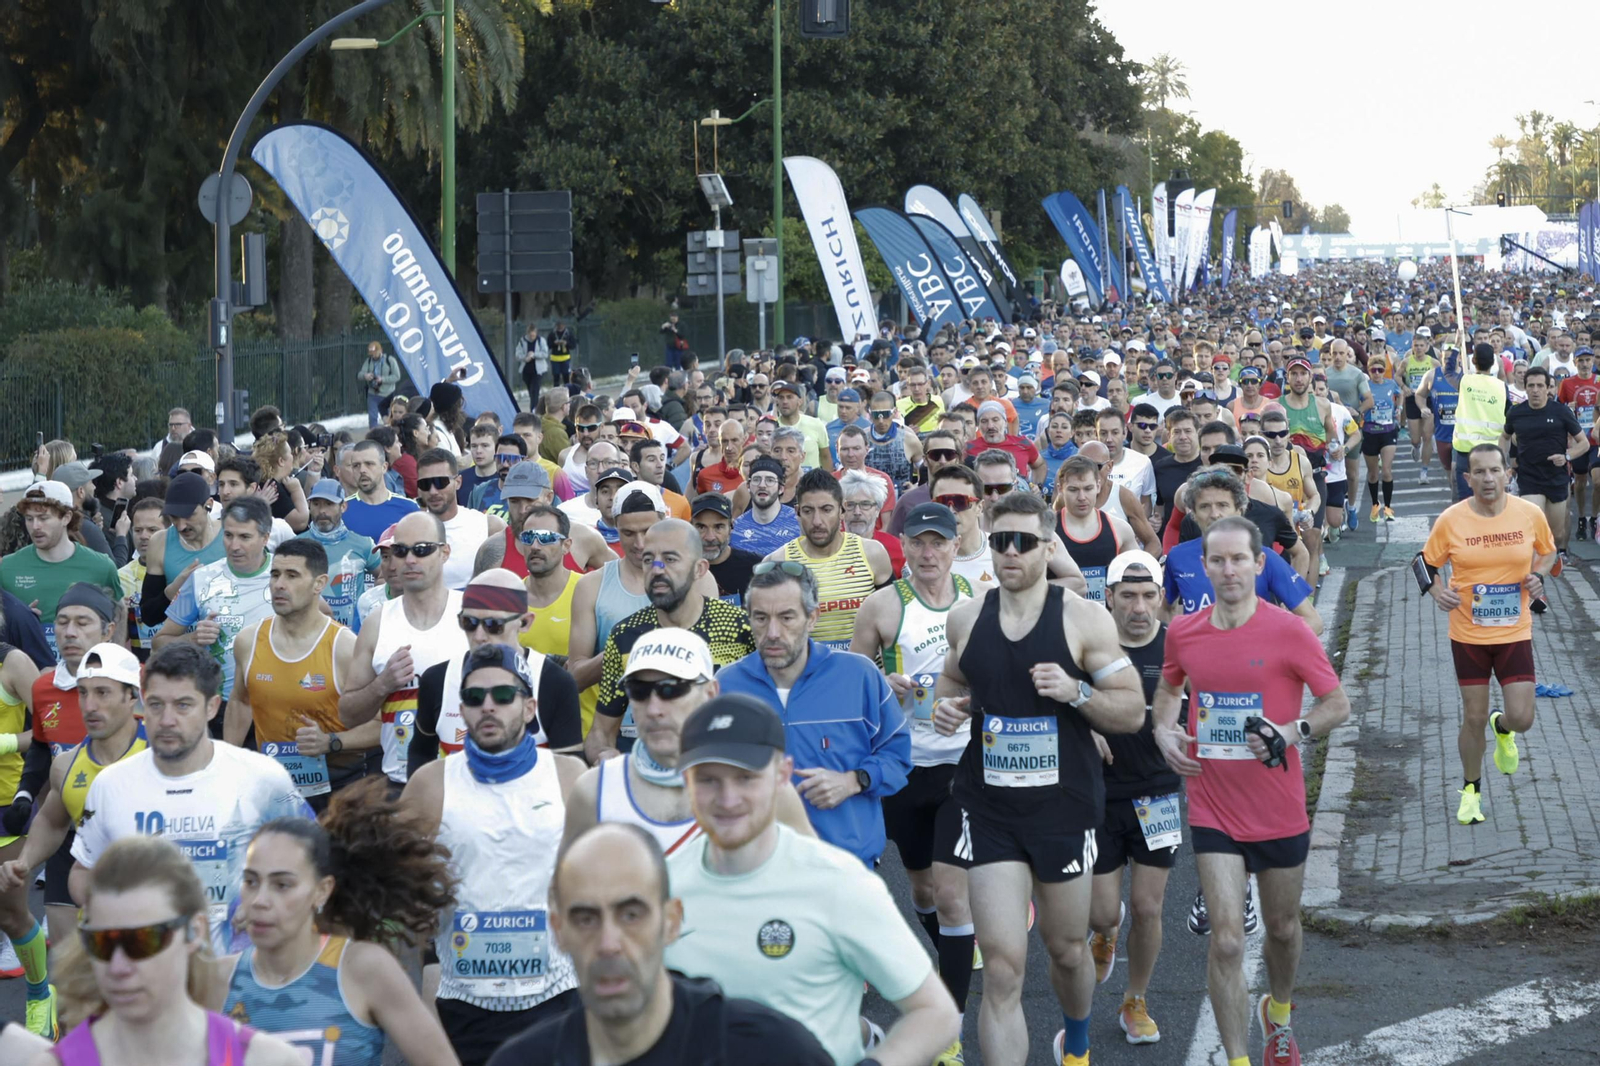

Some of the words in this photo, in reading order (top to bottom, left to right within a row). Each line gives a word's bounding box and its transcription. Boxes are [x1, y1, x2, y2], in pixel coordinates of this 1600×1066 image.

[1465, 536, 1482, 547] TOP
[1482, 530, 1524, 544] RUNNERS
[1086, 590, 1101, 600] ING
[1489, 585, 1516, 593] ZURICH
[1472, 607, 1502, 617] PEDRO
[927, 623, 945, 635] ROY
[914, 636, 938, 654] ROAD
[634, 643, 696, 665] FRANCE
[1217, 696, 1254, 706] ZURICH
[1006, 721, 1048, 732] ZURICH
[1218, 716, 1237, 726] 6655
[281, 745, 299, 754] ZUR
[1007, 743, 1030, 752] 6675
[985, 753, 1057, 769] NIMANDER
[291, 772, 323, 783] AHUD
[134, 811, 164, 837] 10
[164, 815, 215, 834] HUELVA
[181, 845, 216, 857] RICH
[483, 915, 535, 929] ZURICH
[484, 942, 512, 954] 7038
[455, 958, 542, 976] @MAYKYR
